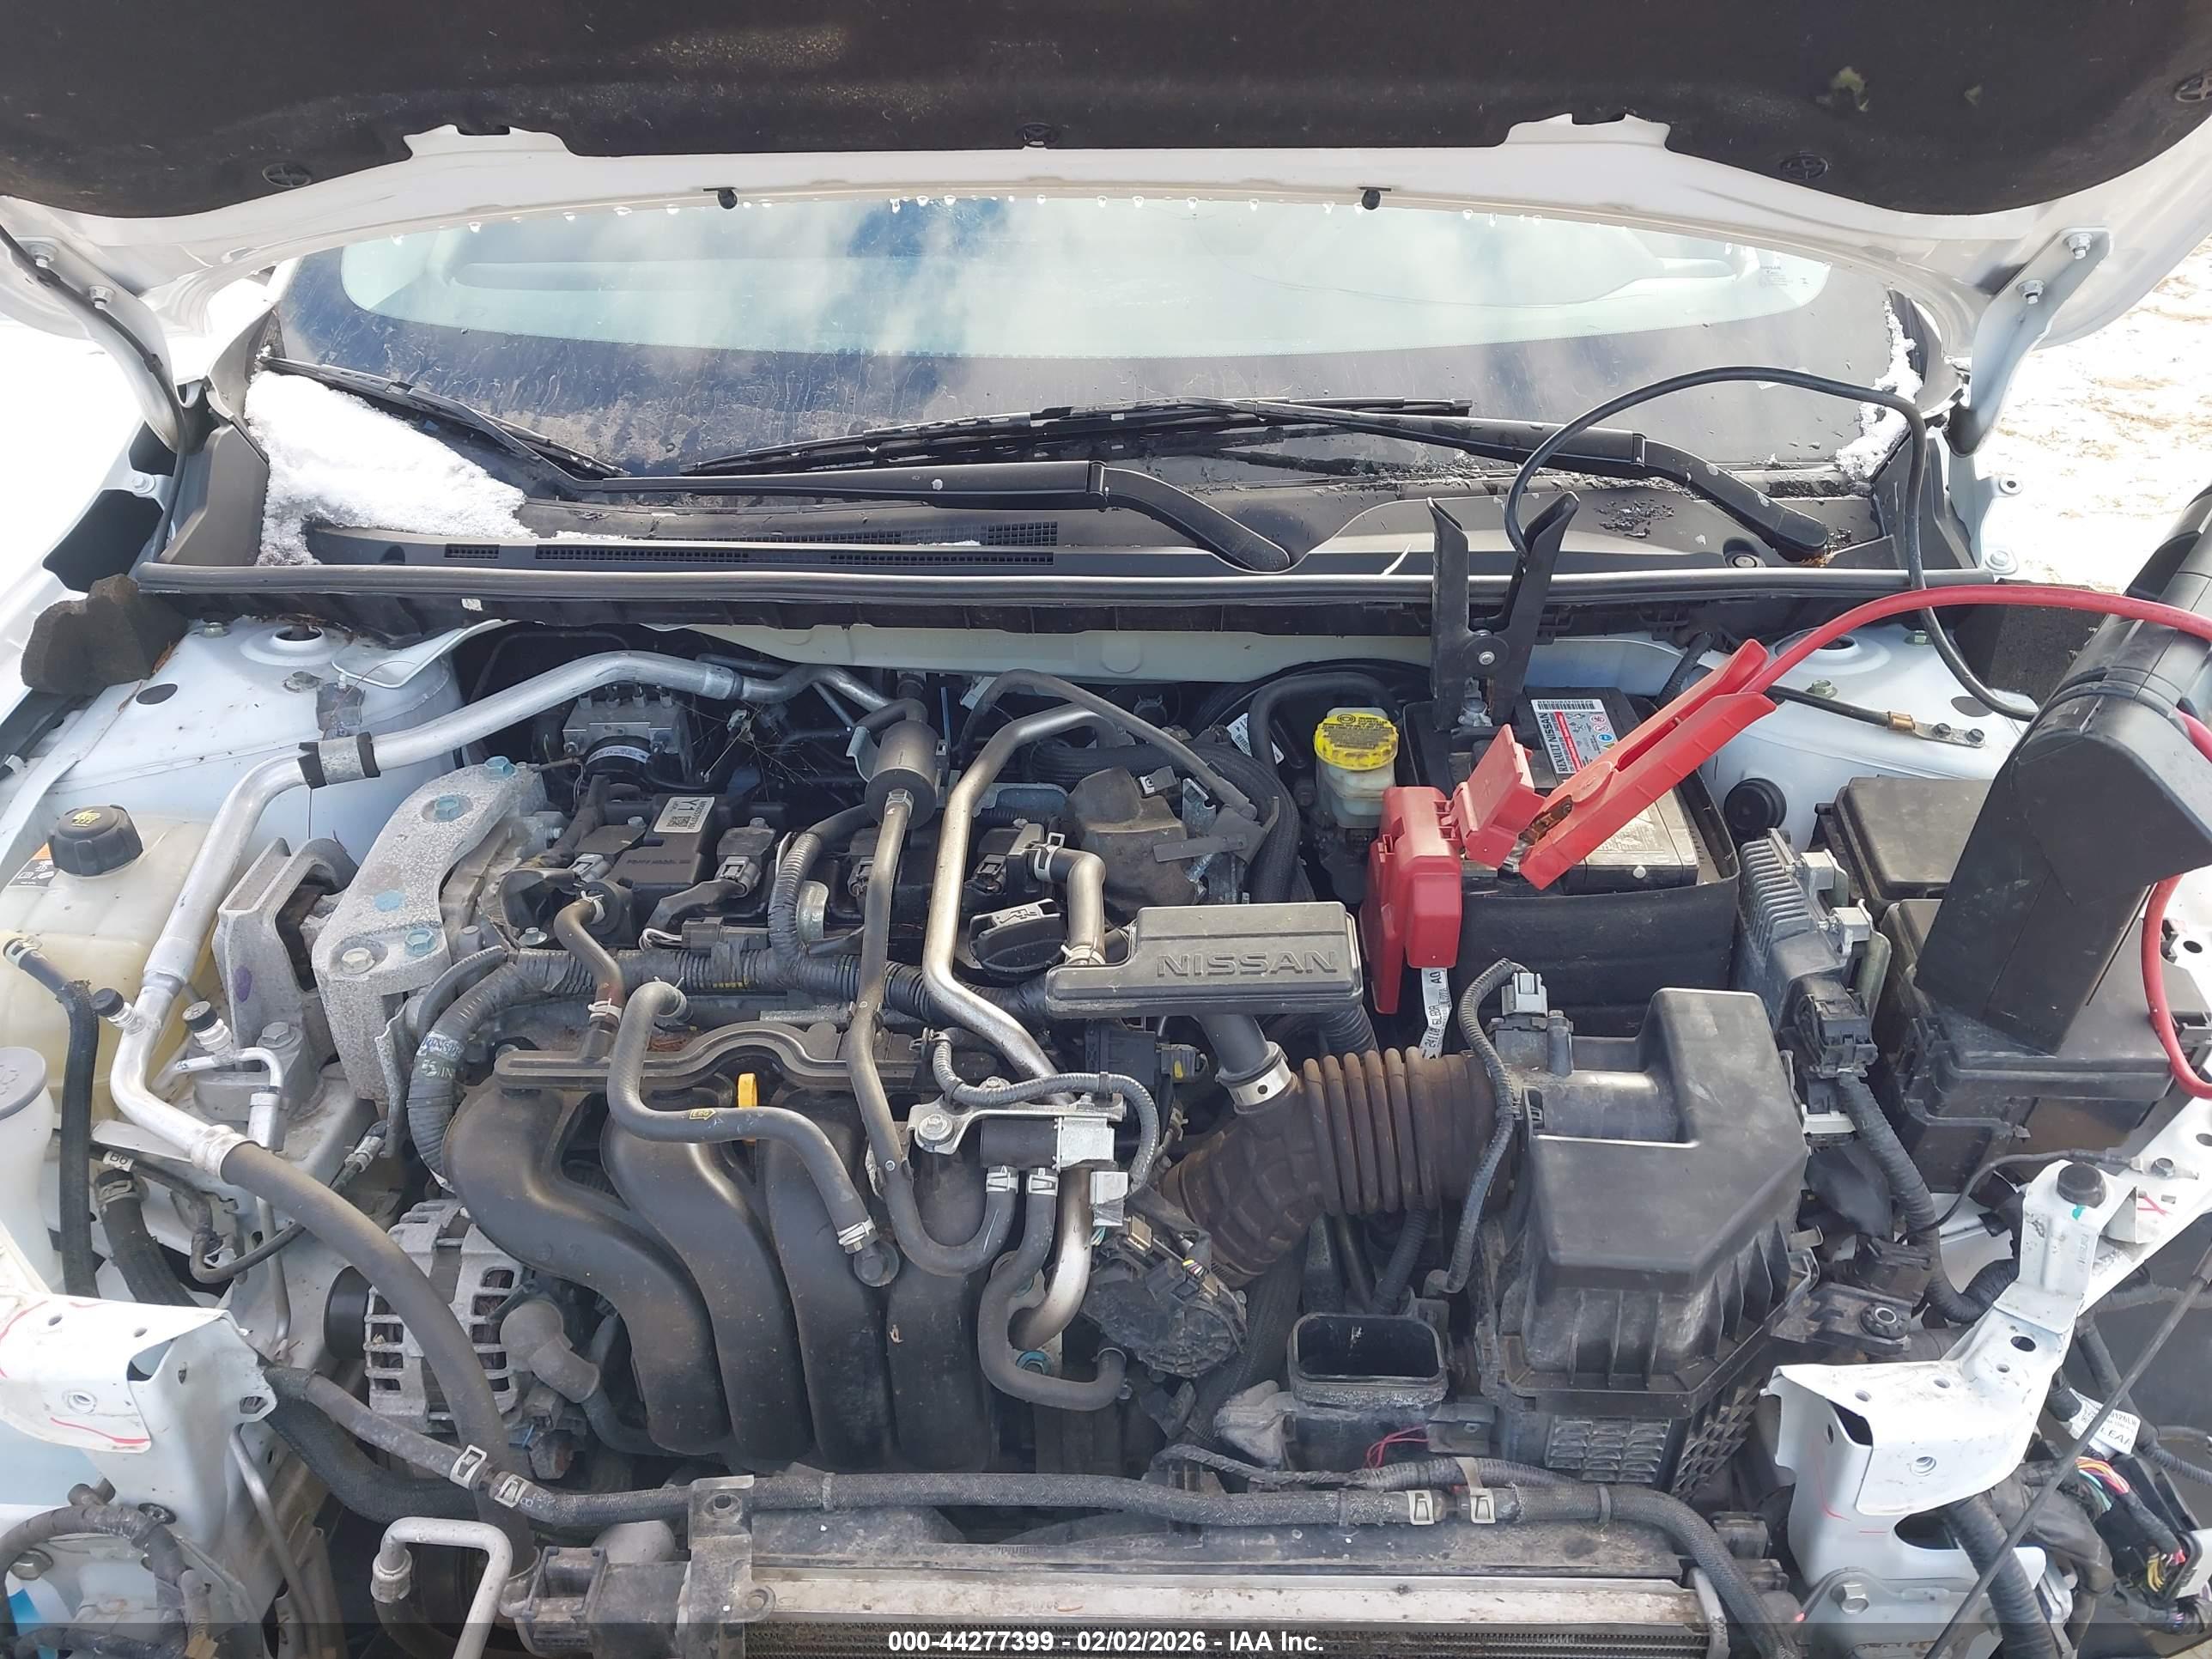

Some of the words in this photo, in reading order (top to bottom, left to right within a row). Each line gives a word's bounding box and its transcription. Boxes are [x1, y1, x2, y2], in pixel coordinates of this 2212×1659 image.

[1538, 712, 1557, 743] NISSAN
[1549, 744, 1569, 772] RENAULT
[678, 799, 700, 811] Y1
[1157, 950, 1338, 977] NISSAN
